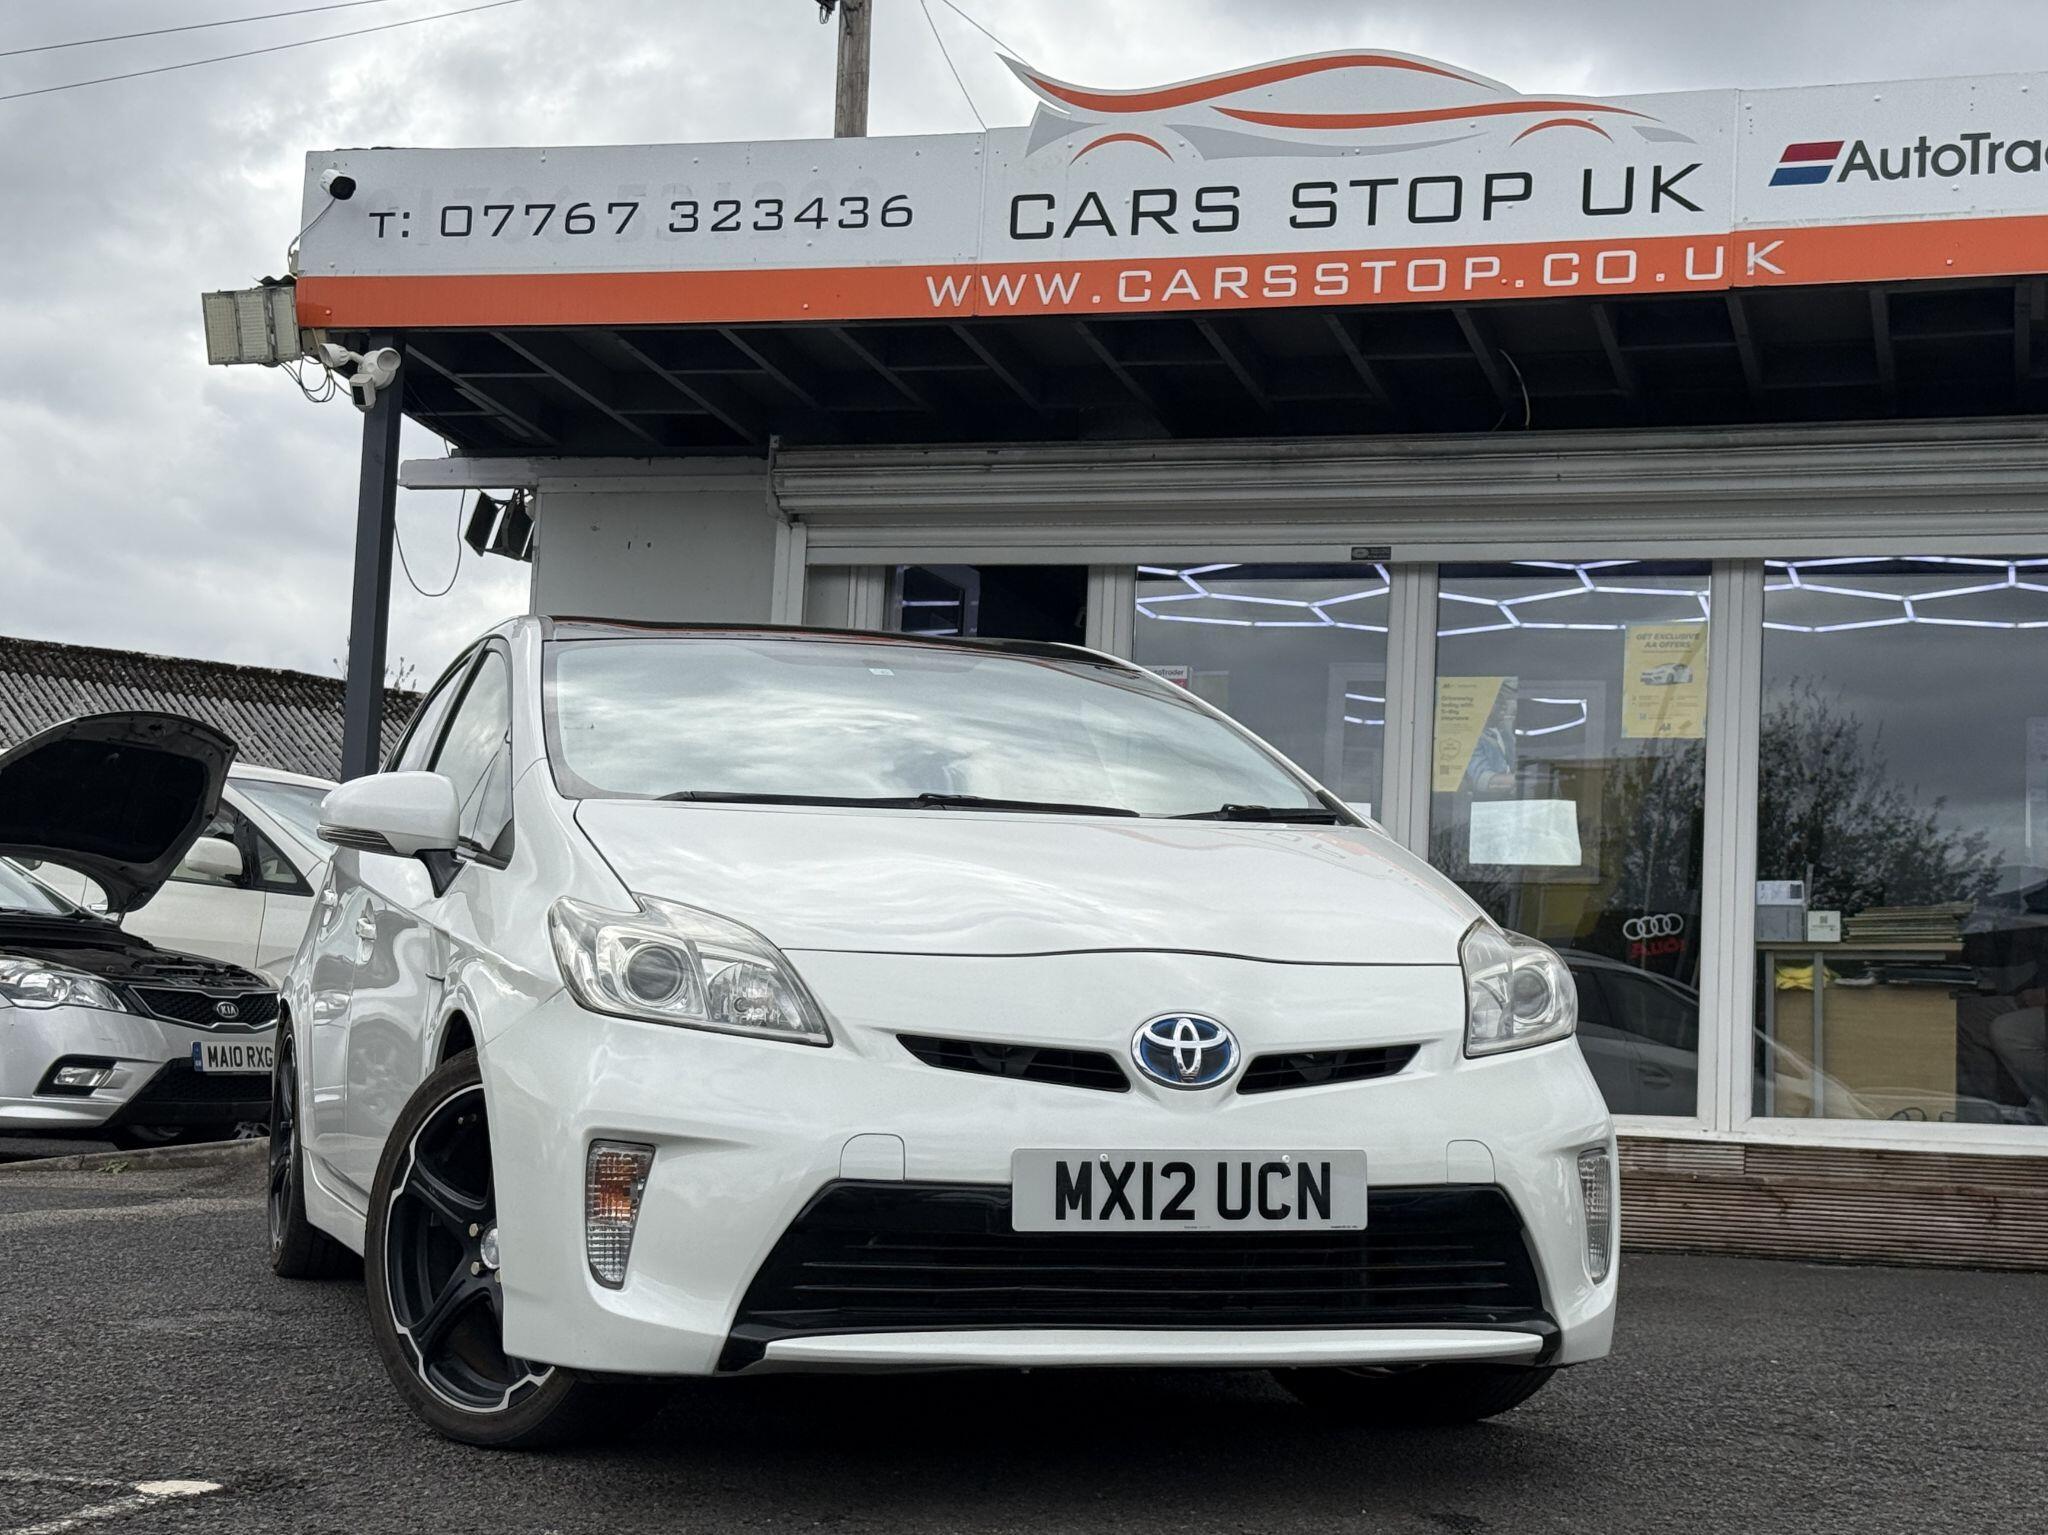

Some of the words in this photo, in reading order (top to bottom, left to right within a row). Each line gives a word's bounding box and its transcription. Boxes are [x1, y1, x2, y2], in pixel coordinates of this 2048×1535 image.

[1837, 132, 2048, 183] AutoTra
[369, 211, 411, 239] T:
[440, 201, 641, 237] 07767
[668, 194, 914, 232] 323436
[1010, 185, 1239, 240] CARS
[1290, 171, 1532, 229] STOP
[1582, 163, 1704, 215] UK
[926, 240, 1786, 308] WWW.CARSSTOP.CO.UK
[220, 1004, 237, 1015] KIA
[207, 1046, 243, 1068] MA10
[247, 1046, 273, 1068] RXG
[1055, 1161, 1196, 1220] MX12
[1217, 1161, 1331, 1220] UCN
